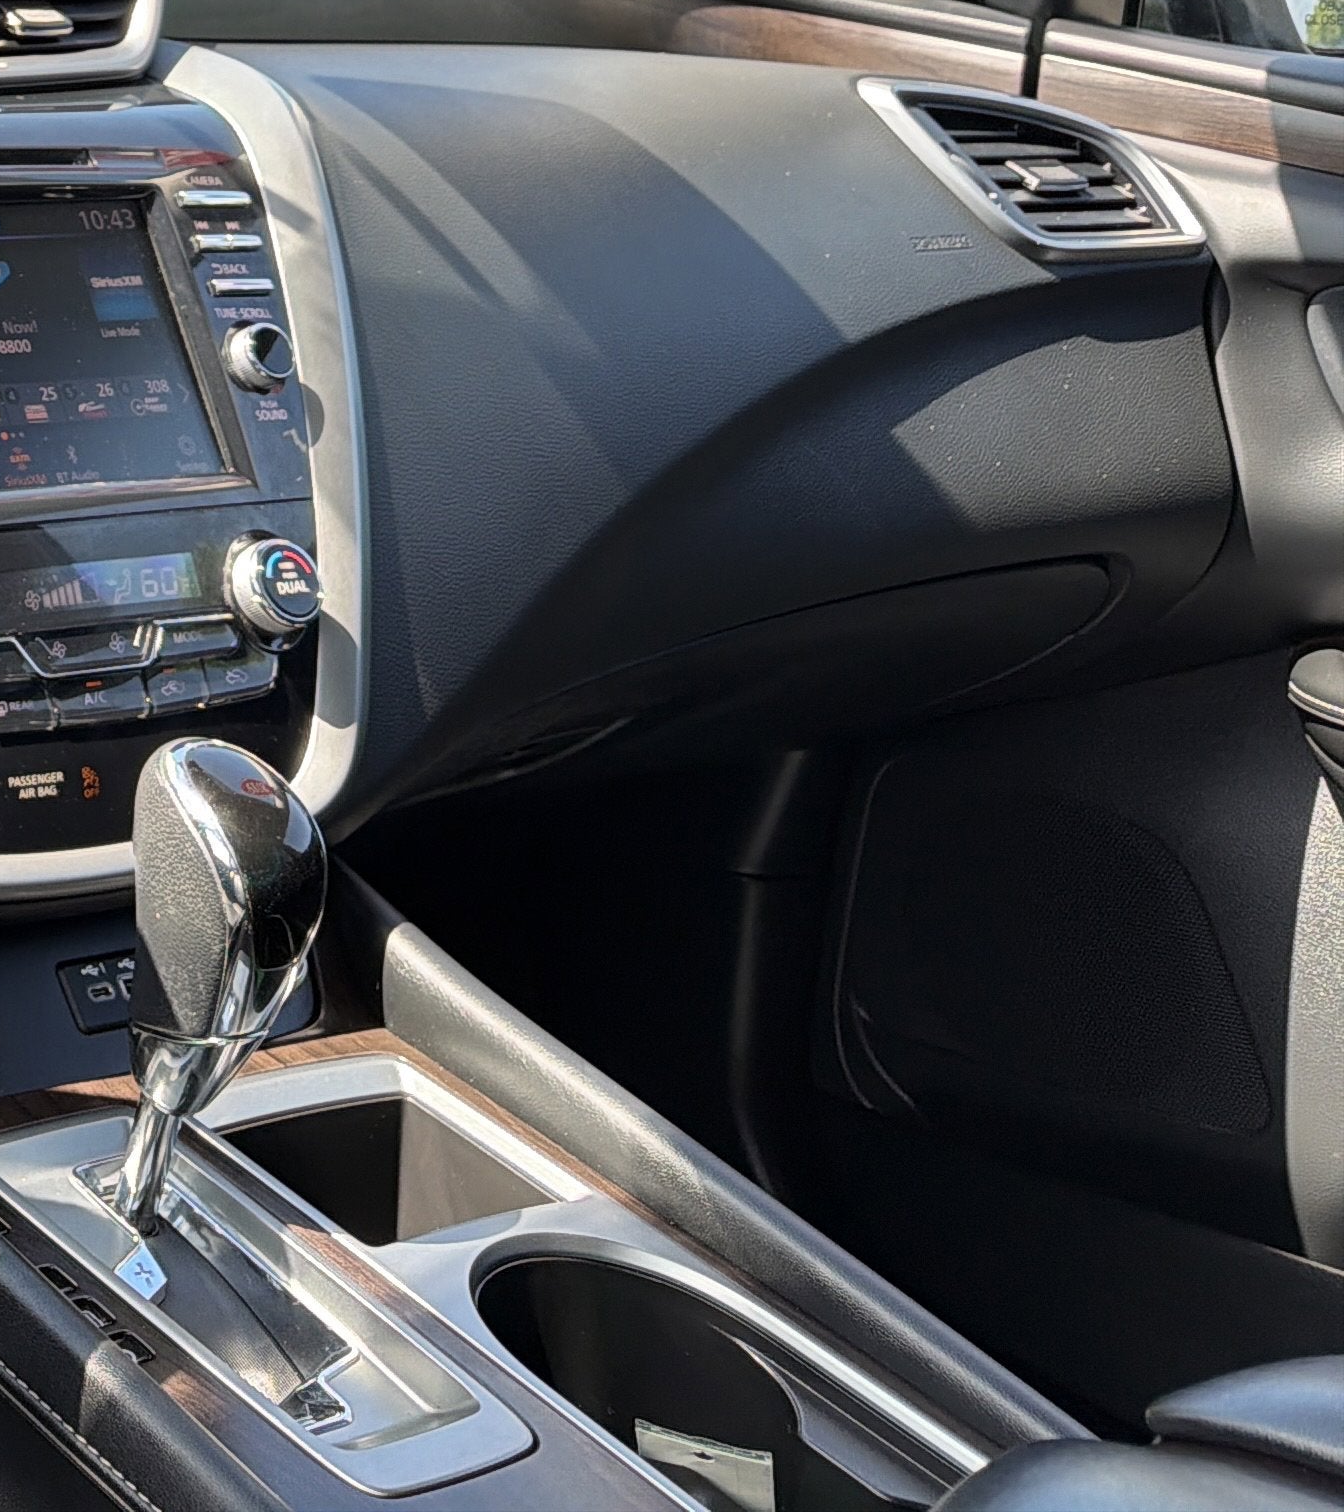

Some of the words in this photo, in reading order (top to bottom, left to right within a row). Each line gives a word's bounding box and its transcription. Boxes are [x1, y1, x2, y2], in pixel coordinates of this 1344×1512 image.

[78, 208, 136, 231] 10:43
[222, 263, 249, 275] BACK
[2, 319, 38, 335] Now!
[39, 387, 58, 401] 25
[96, 383, 113, 398] 26
[144, 379, 169, 394] 308
[255, 409, 288, 421] SOUND
[276, 580, 311, 596] DUAL
[84, 691, 108, 706] A/C
[8, 771, 64, 787] PASSENGER
[18, 788, 36, 800] AIR
[37, 786, 58, 799] BAG
